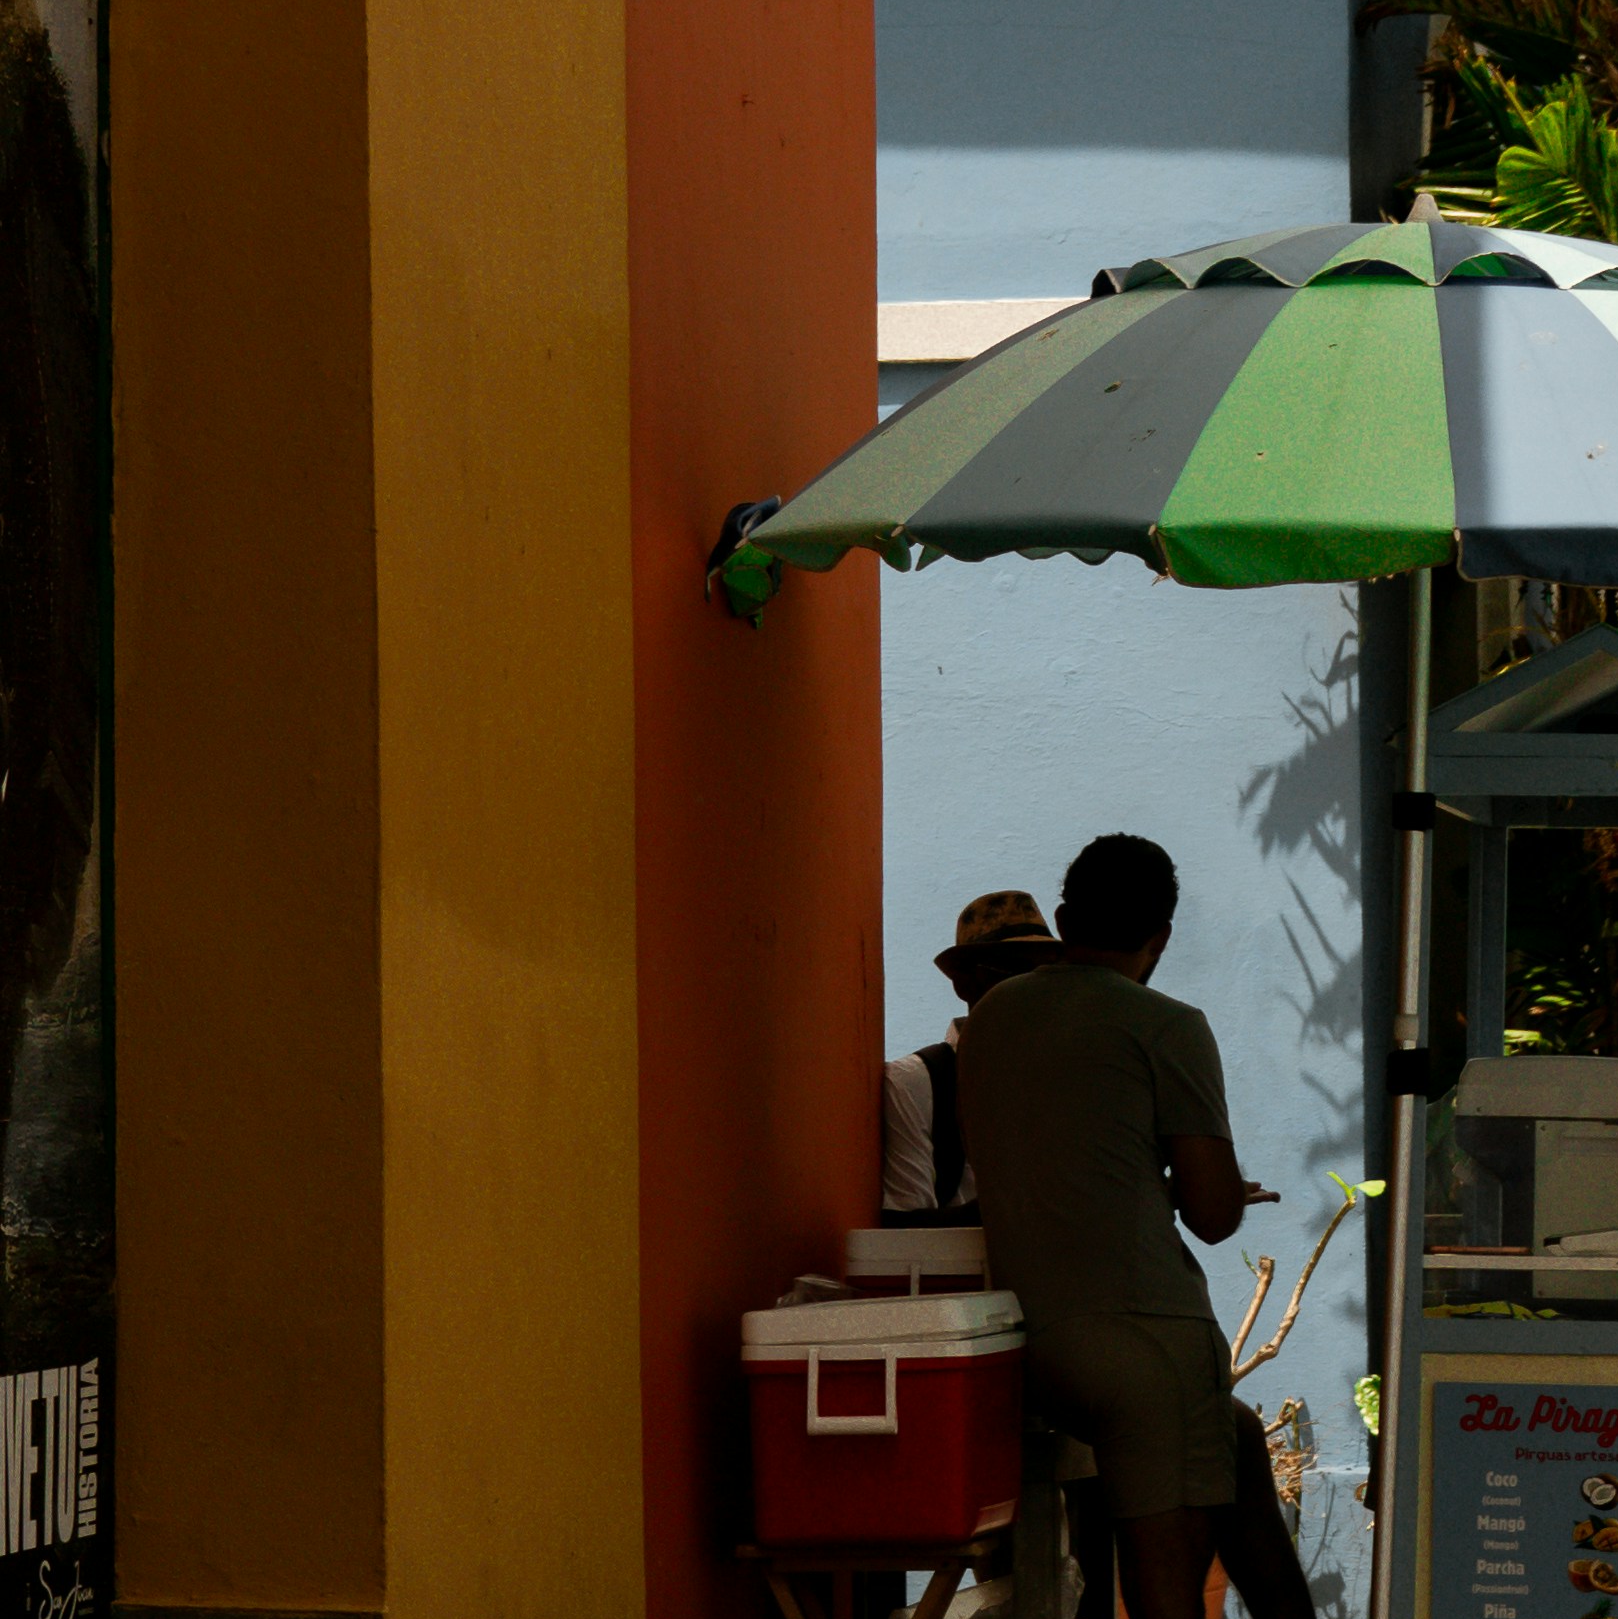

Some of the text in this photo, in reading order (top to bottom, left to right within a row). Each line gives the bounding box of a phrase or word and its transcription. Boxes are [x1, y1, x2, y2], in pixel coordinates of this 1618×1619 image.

[1460, 1395, 1521, 1432] La
[42, 1365, 77, 1546] TU
[78, 1358, 98, 1538] HISTORIA
[1515, 1447, 1571, 1462] Pirguas
[1486, 1471, 1518, 1487] Coco
[1478, 1515, 1525, 1532] Mangó
[1483, 1540, 1519, 1550] (Mango)
[1477, 1560, 1524, 1575] Parcha
[1485, 1604, 1516, 1619] Piña
